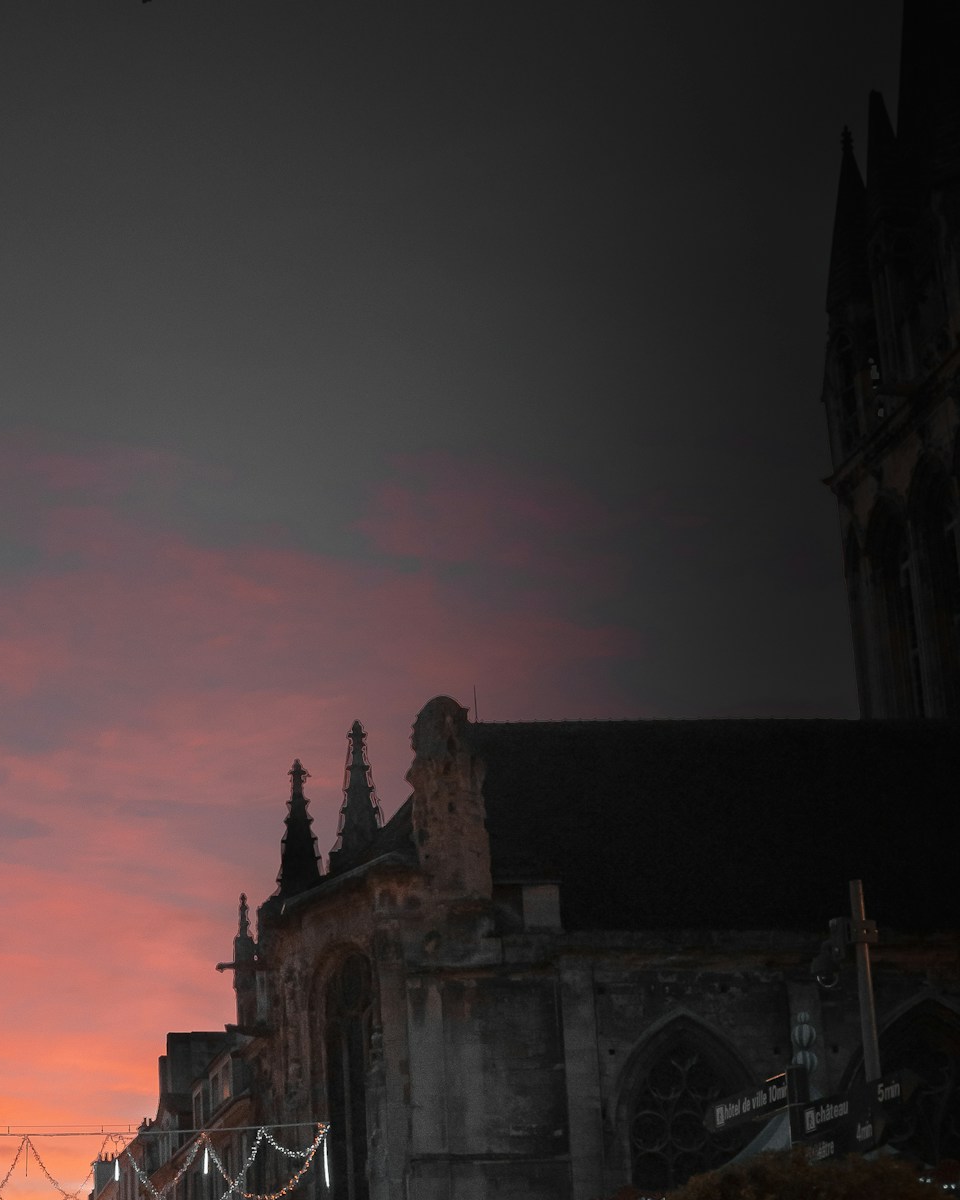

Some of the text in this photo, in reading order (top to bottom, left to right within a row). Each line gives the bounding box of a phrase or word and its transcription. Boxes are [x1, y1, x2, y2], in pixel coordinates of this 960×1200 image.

[724, 1098, 741, 1121] hôtel
[742, 1096, 751, 1113] de
[752, 1090, 768, 1110] ville
[815, 1080, 901, 1125] château 5min
[856, 1120, 873, 1142] 4min
